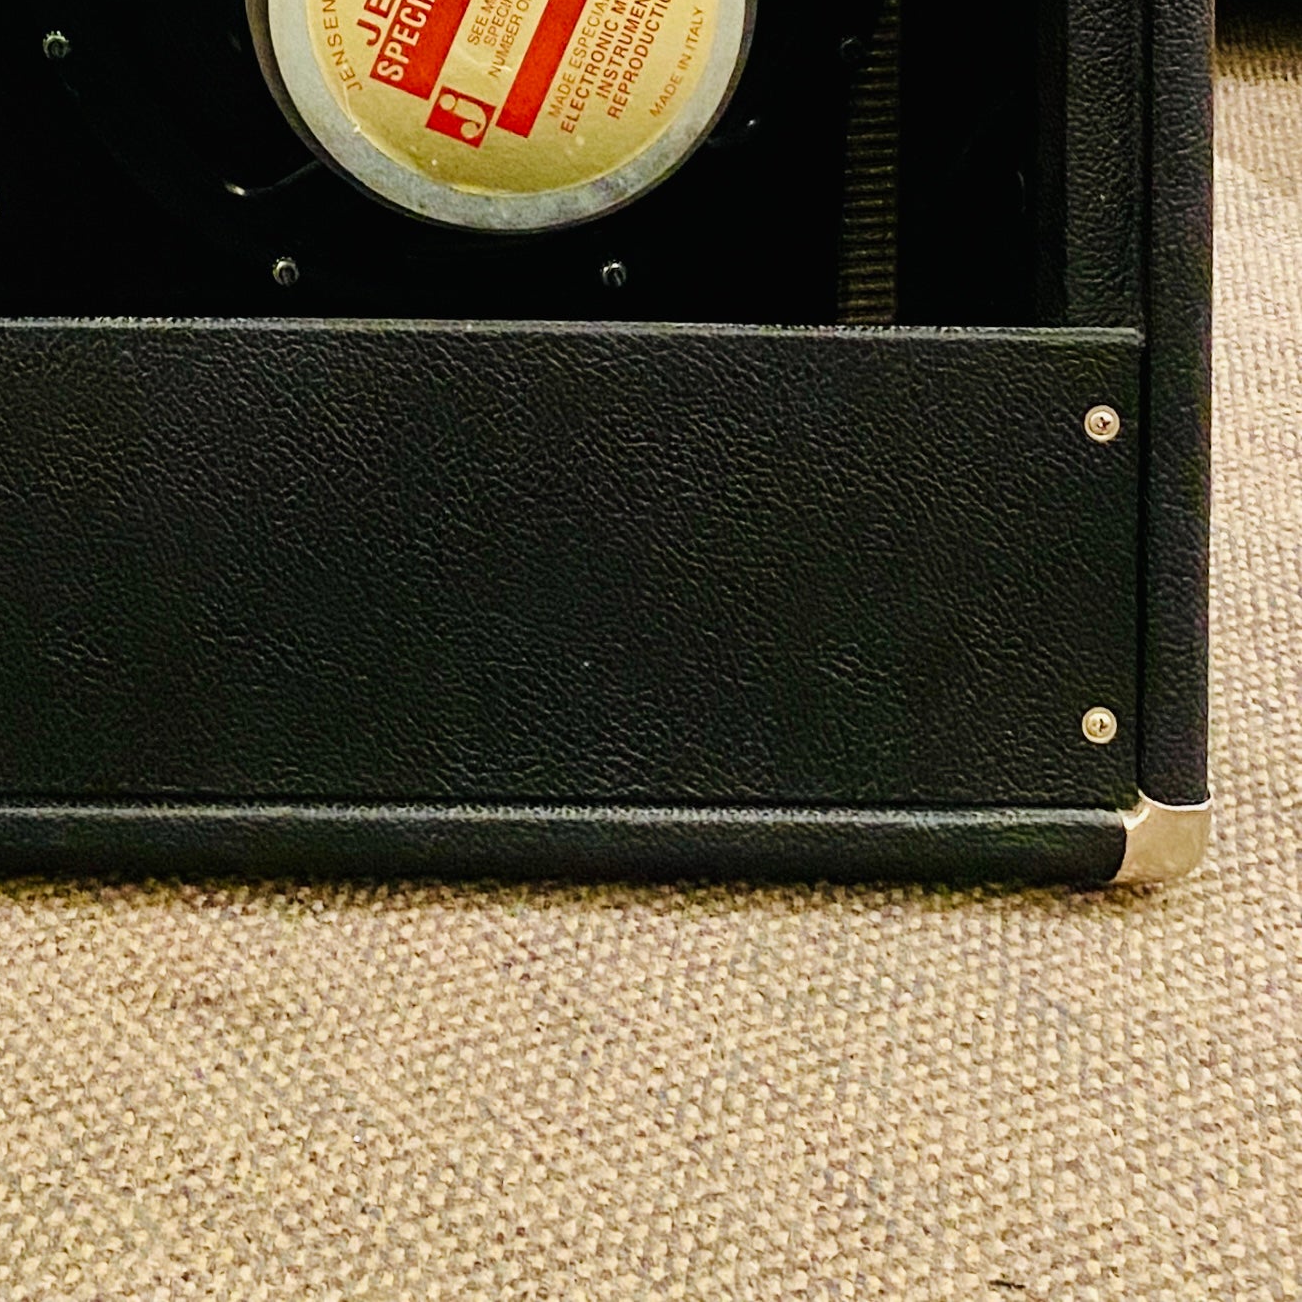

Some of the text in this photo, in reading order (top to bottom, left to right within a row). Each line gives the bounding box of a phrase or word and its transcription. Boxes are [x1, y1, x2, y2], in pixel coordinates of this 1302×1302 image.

[468, 14, 489, 46] SEE
[488, 13, 523, 79] NUMBER
[649, 5, 705, 117] MADE IN ITALY
[548, 71, 576, 118] MADE
[560, 19, 619, 134] ELECTRONIC
